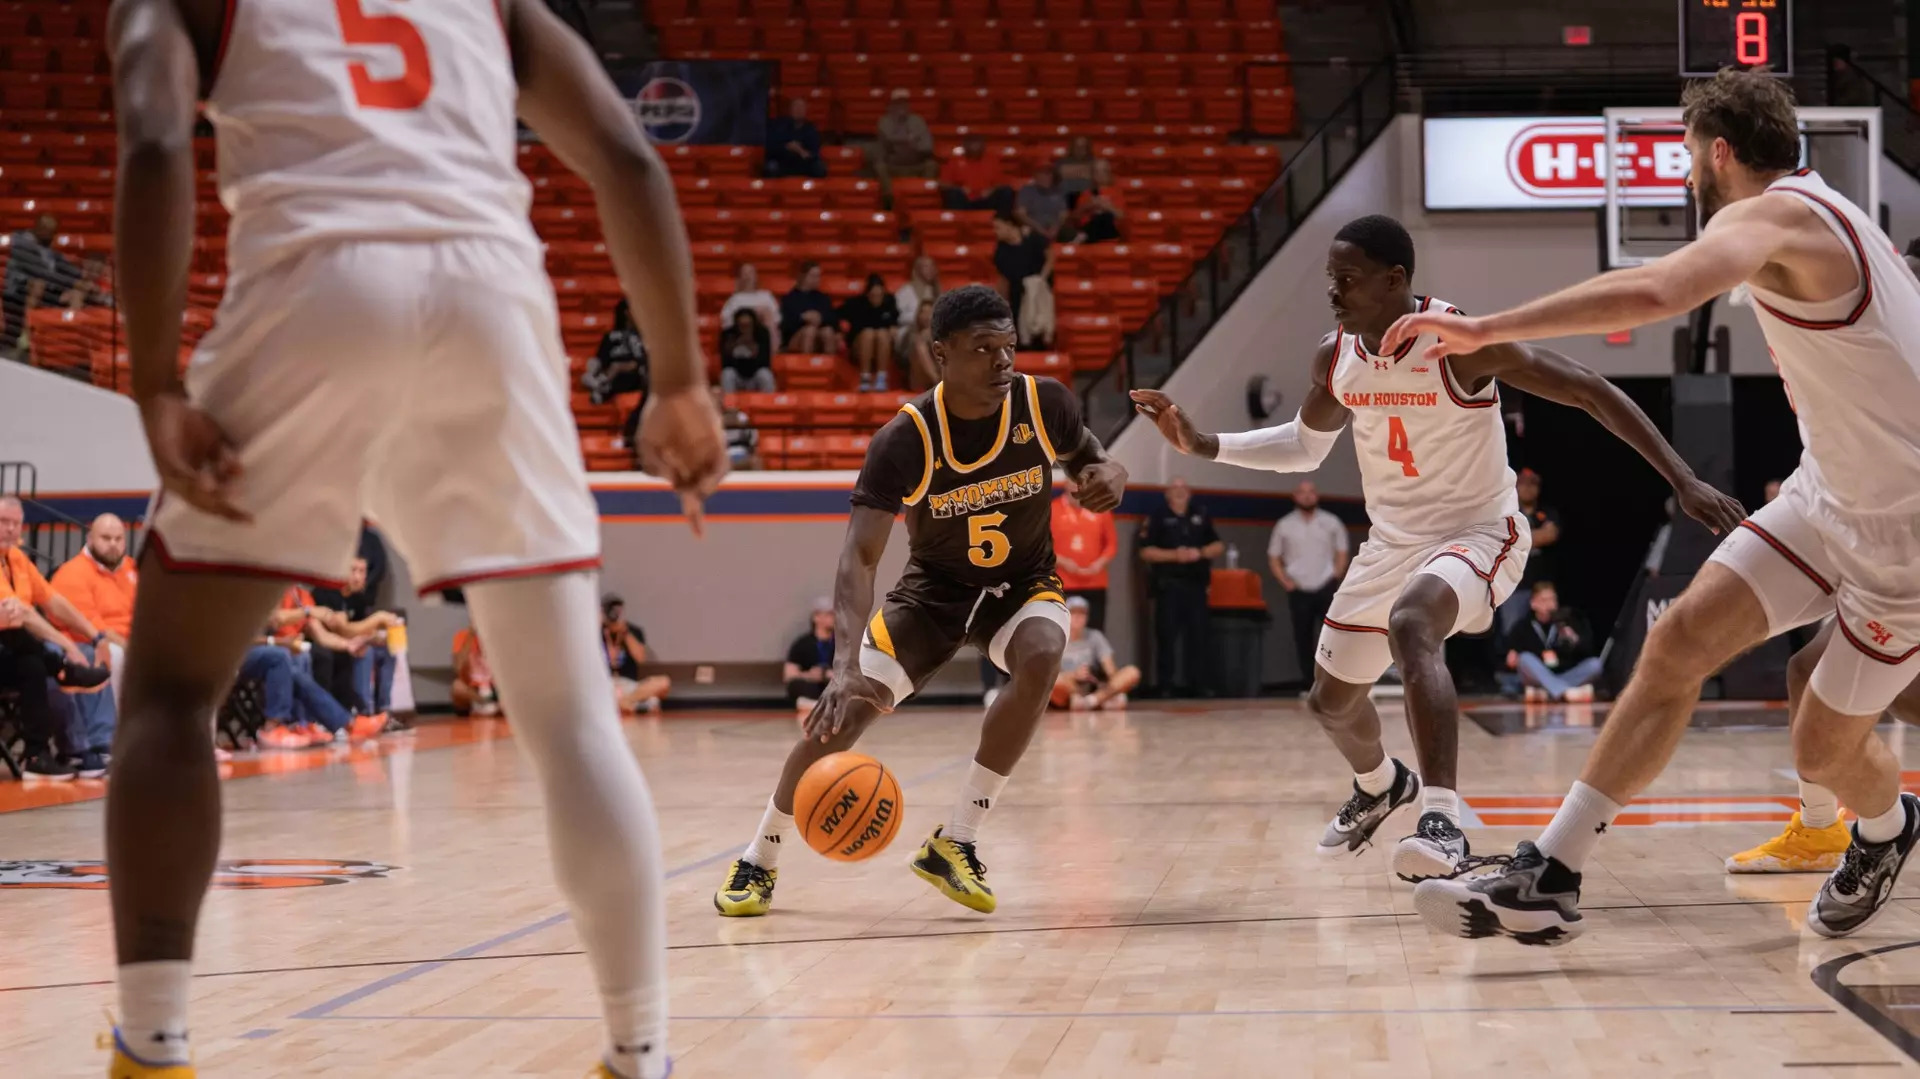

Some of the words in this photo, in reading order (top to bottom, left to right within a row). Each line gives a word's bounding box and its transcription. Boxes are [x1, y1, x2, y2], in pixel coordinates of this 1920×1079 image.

[335, 0, 433, 110] 5
[1736, 11, 1768, 64] 8
[1532, 142, 1690, 181] H-E-B
[1343, 392, 1371, 407] SAM
[1373, 392, 1438, 407] HOUSTON
[1388, 416, 1420, 477] 4
[928, 464, 1043, 519] WYOMING
[967, 510, 1013, 568] 5
[820, 788, 859, 835] NCAA
[842, 798, 894, 856] Wilson
